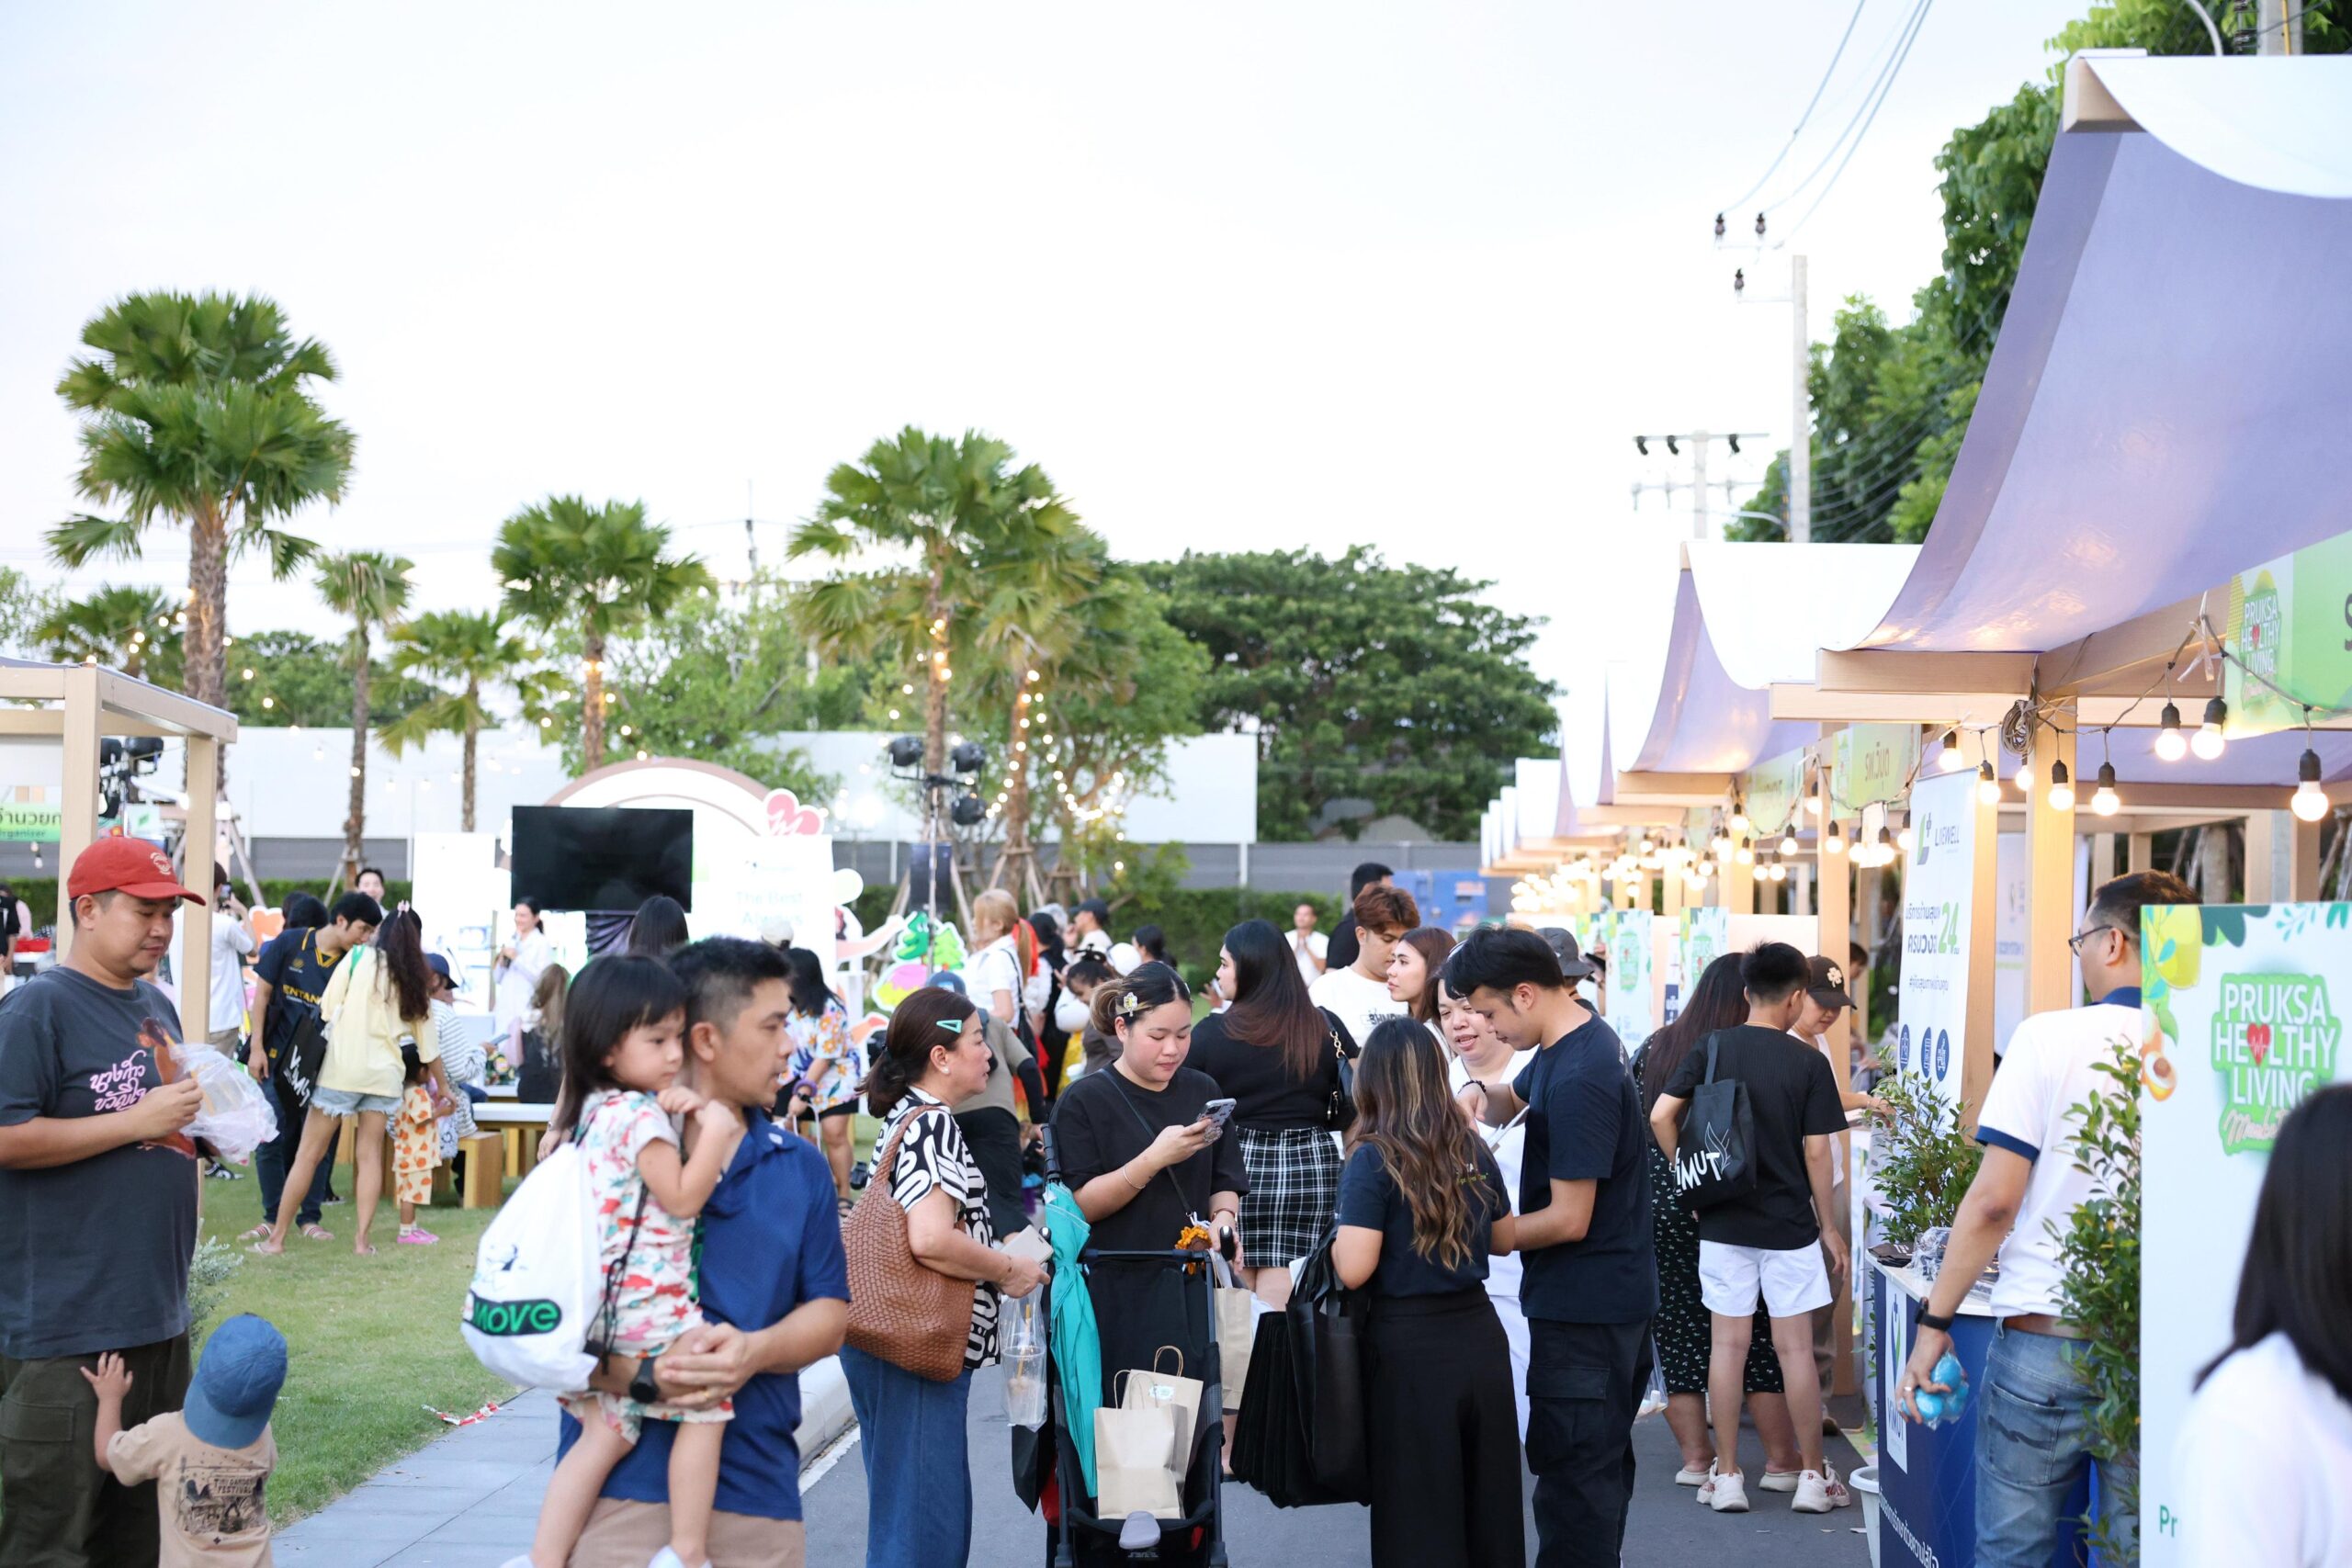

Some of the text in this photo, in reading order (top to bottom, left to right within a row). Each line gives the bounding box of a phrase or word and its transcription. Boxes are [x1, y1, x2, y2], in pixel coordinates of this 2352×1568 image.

[2245, 594, 2278, 626] PRUKSA
[2245, 648, 2275, 677] LIVING
[1939, 901, 1959, 953] 24
[2224, 983, 2327, 1025] PRUKSA
[2233, 1066, 2314, 1109] LIVING
